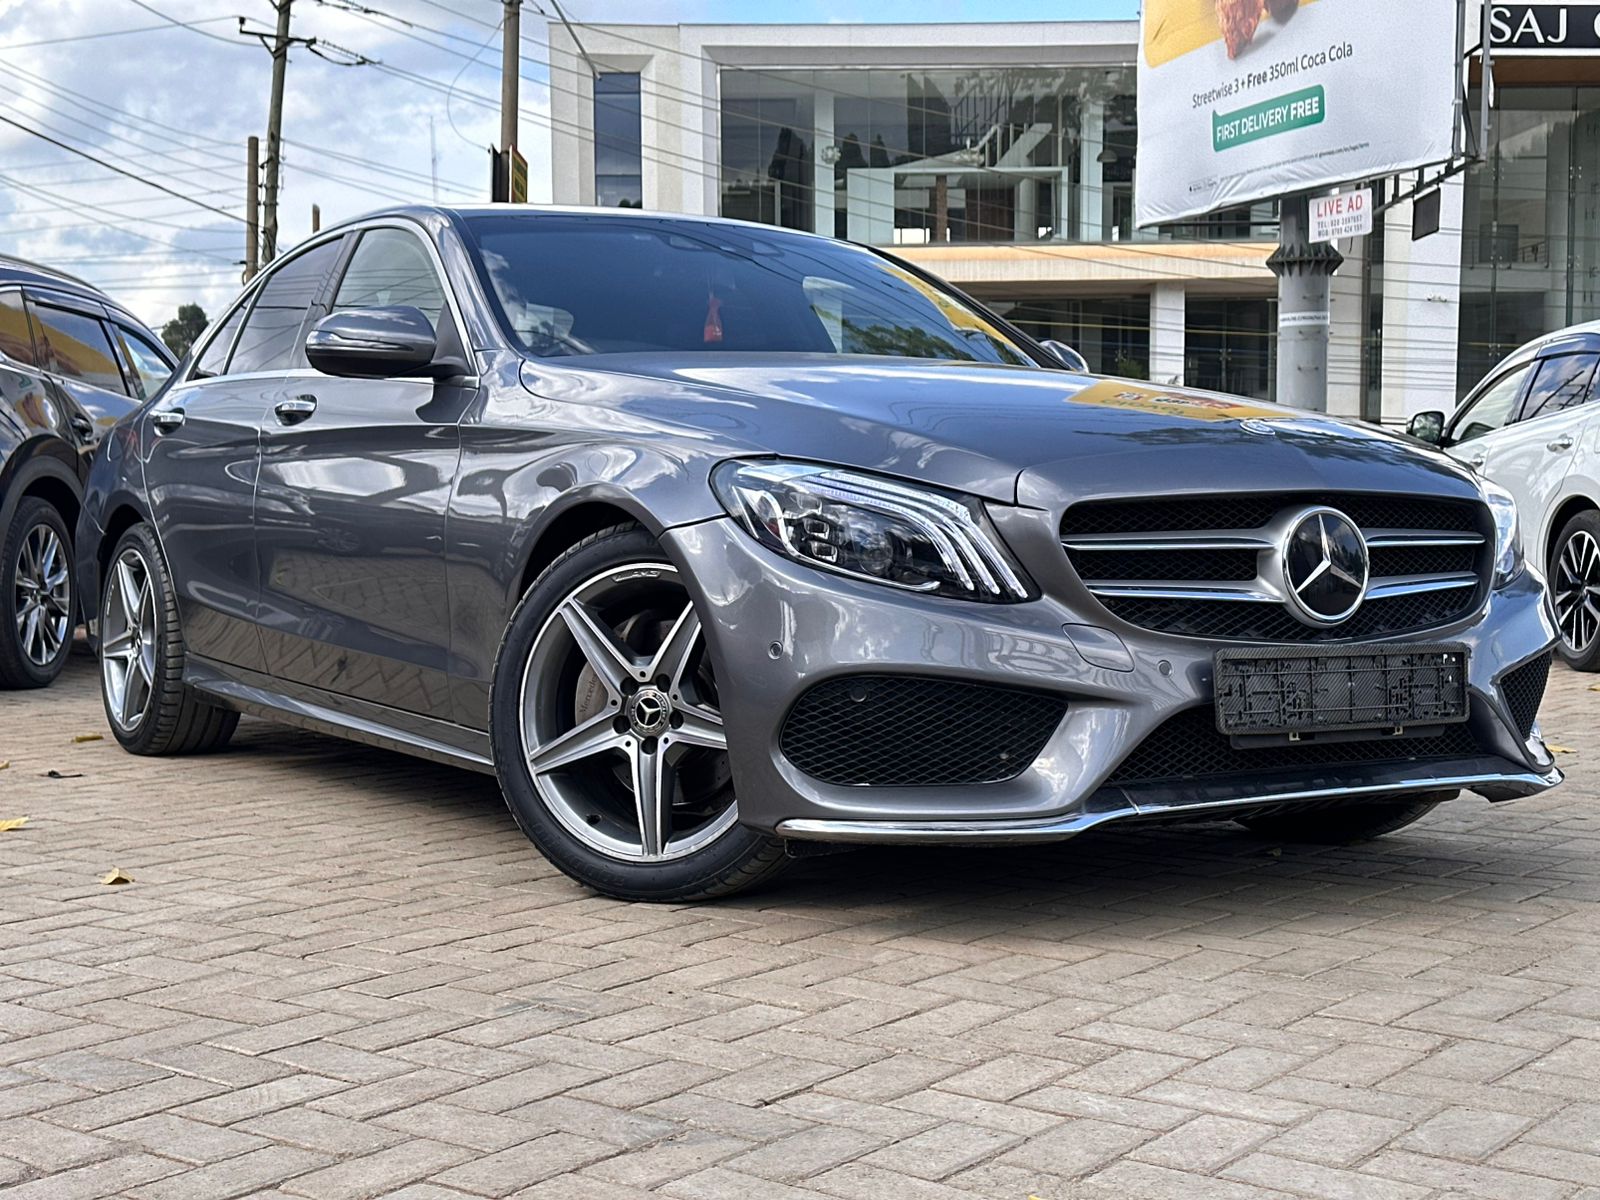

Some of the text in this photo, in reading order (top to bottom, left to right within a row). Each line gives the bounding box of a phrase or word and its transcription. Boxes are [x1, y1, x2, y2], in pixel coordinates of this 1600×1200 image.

[1490, 7, 1567, 43] SAJ
[1192, 82, 1232, 109] Streetwise
[1234, 79, 1239, 93] 3
[1247, 71, 1267, 89] Free
[1269, 58, 1298, 81] 350ml
[1301, 53, 1326, 70] Coca
[1329, 42, 1353, 62] Cola
[1216, 96, 1319, 142] FIRST DELIVERY FREE
[1317, 195, 1362, 218] LIVE AD
